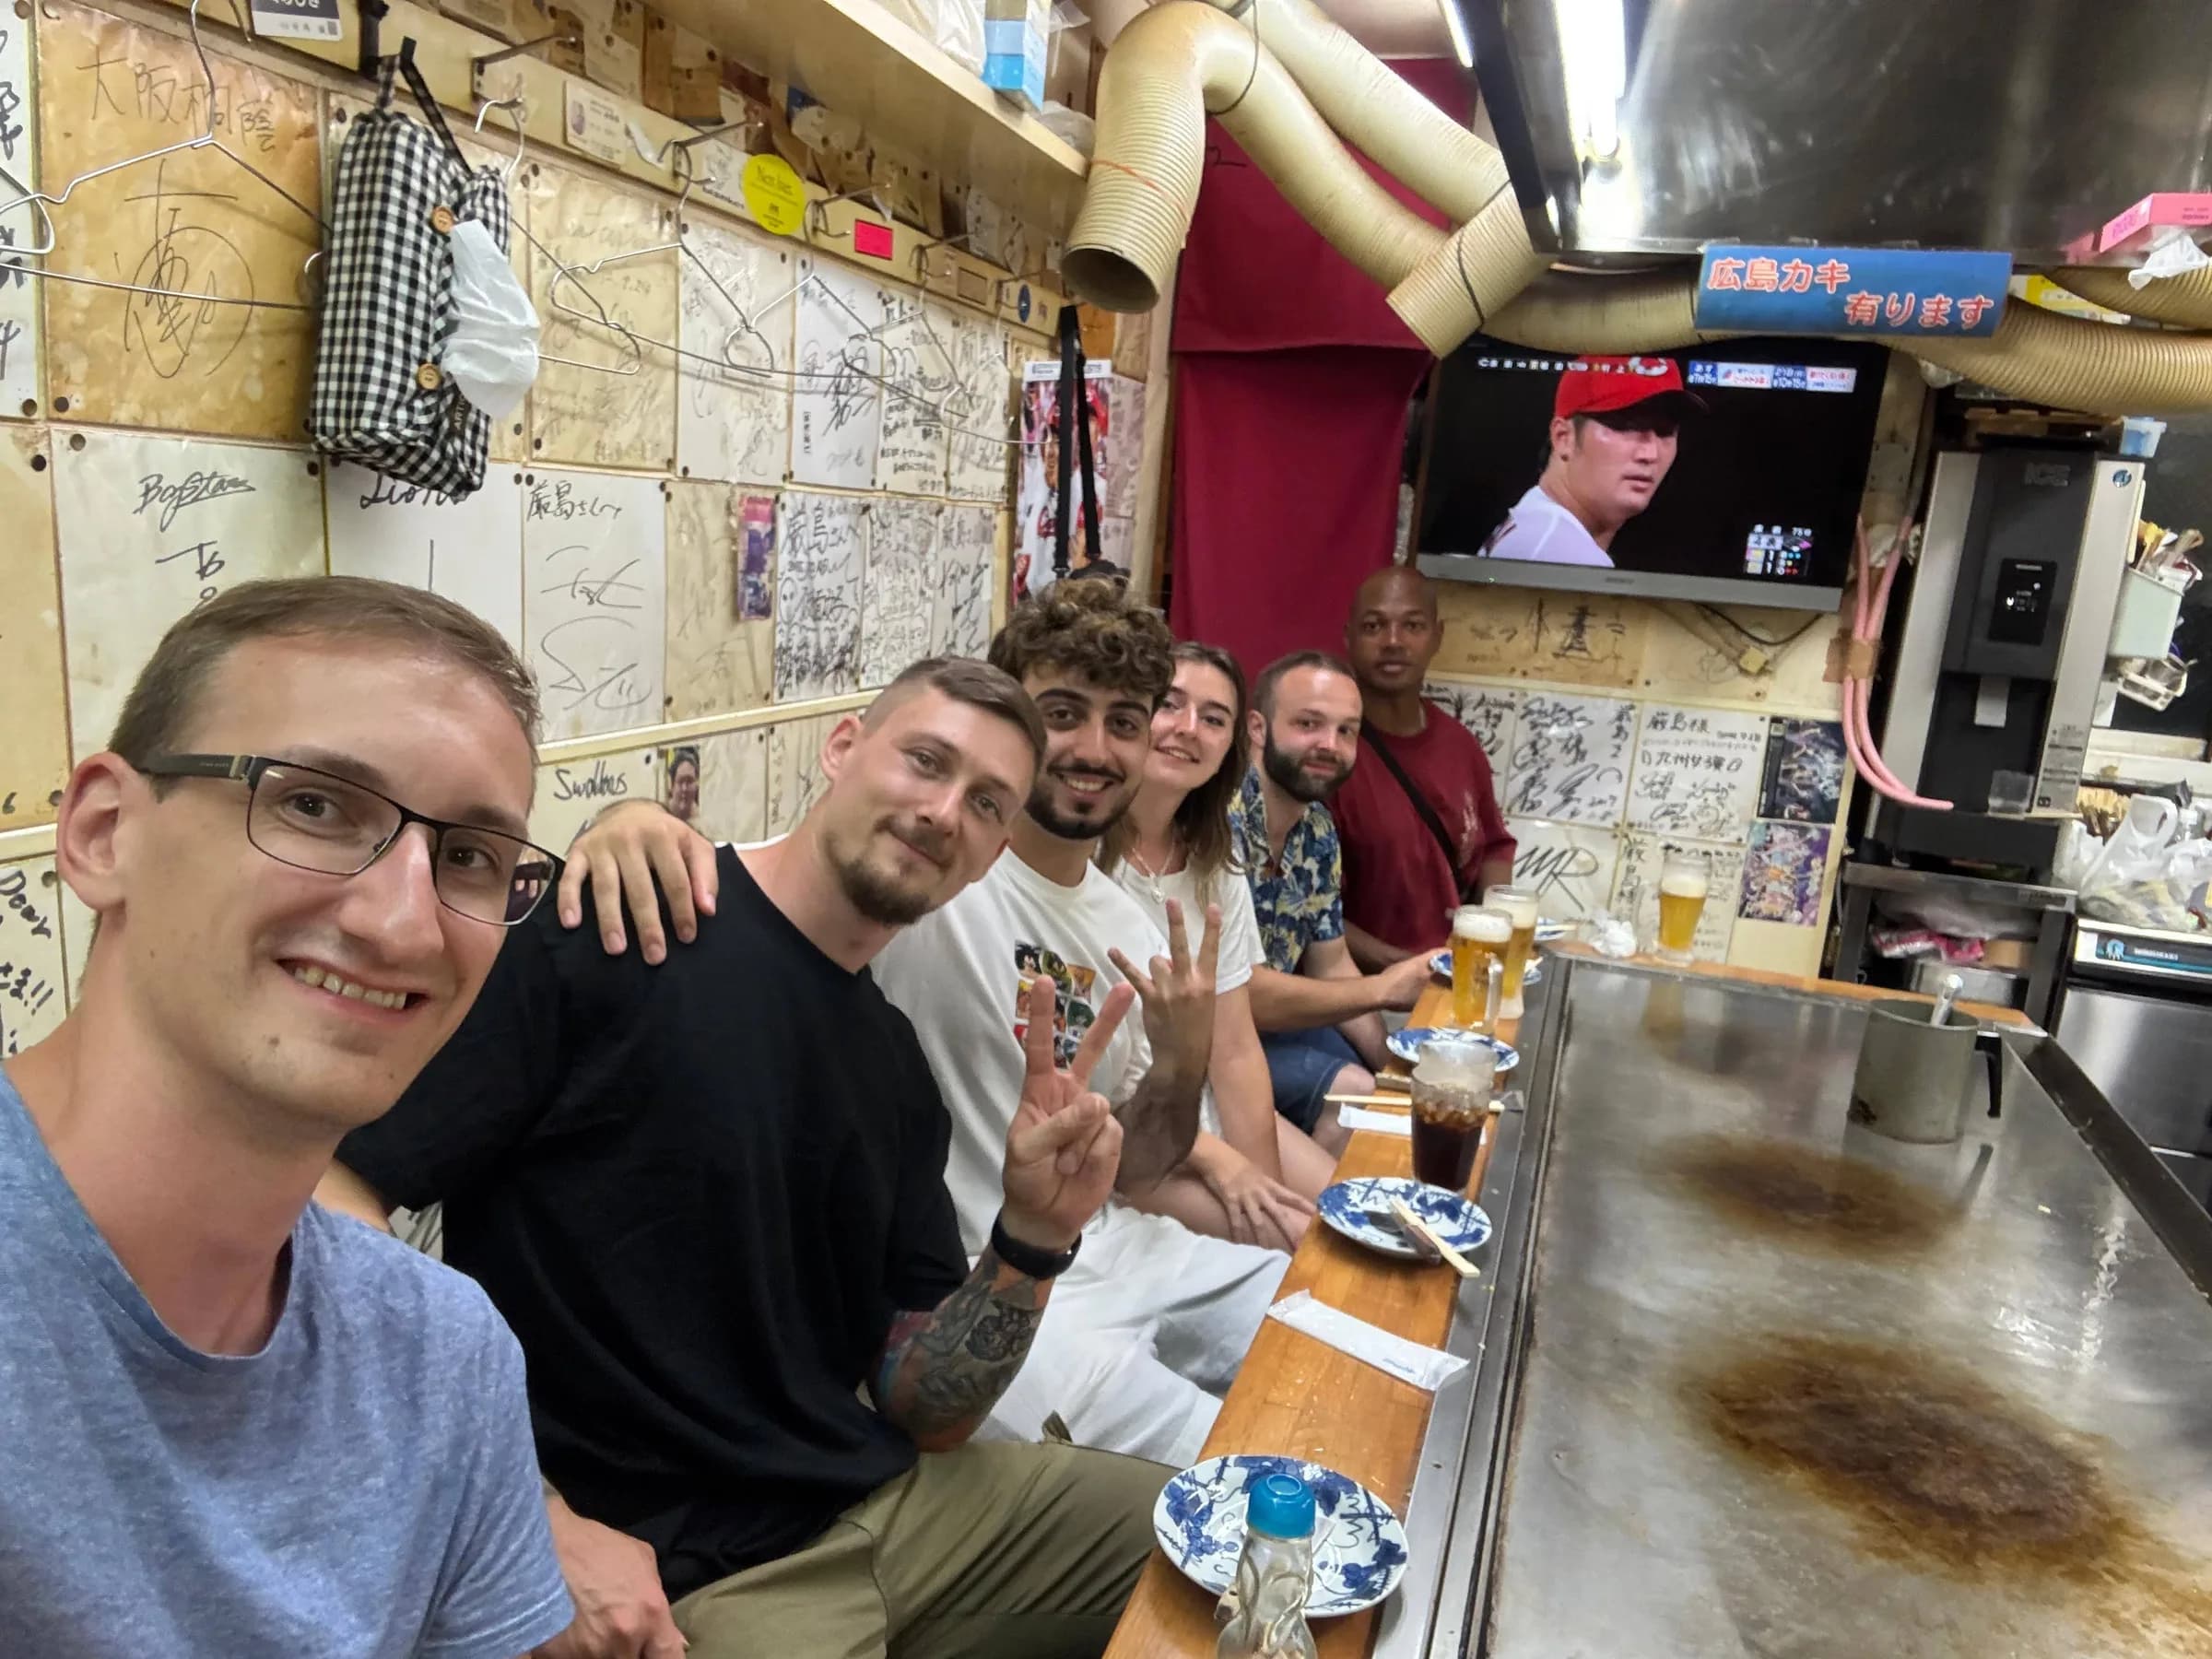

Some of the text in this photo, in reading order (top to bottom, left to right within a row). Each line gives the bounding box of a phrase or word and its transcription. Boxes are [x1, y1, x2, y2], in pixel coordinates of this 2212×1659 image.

[1706, 256, 1852, 294] 広島カキ
[1844, 291, 1994, 329] 有ります
